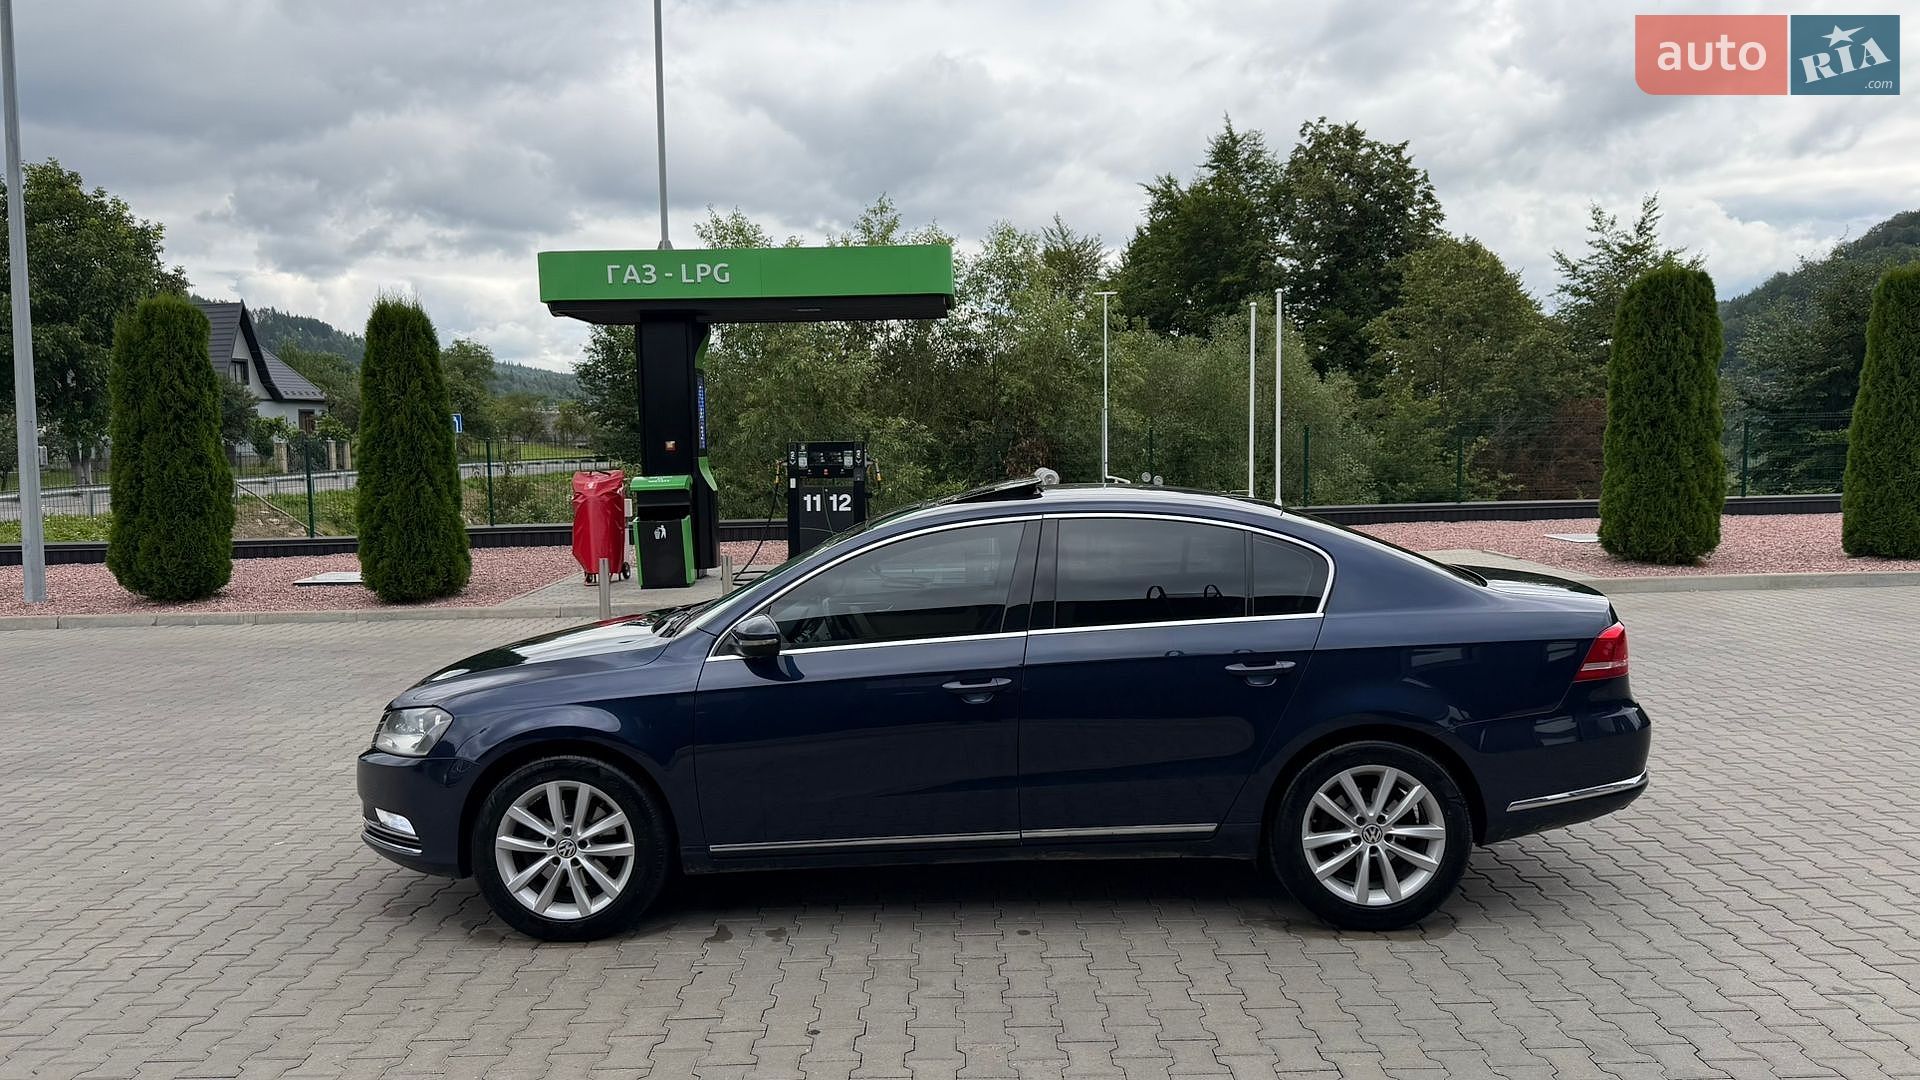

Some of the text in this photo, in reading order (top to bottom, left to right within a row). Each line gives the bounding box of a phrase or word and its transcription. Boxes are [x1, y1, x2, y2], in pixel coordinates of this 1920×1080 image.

[607, 264, 657, 284] ГАЗ
[681, 263, 730, 283] LPG
[803, 494, 821, 512] 11
[829, 494, 852, 512] 12
